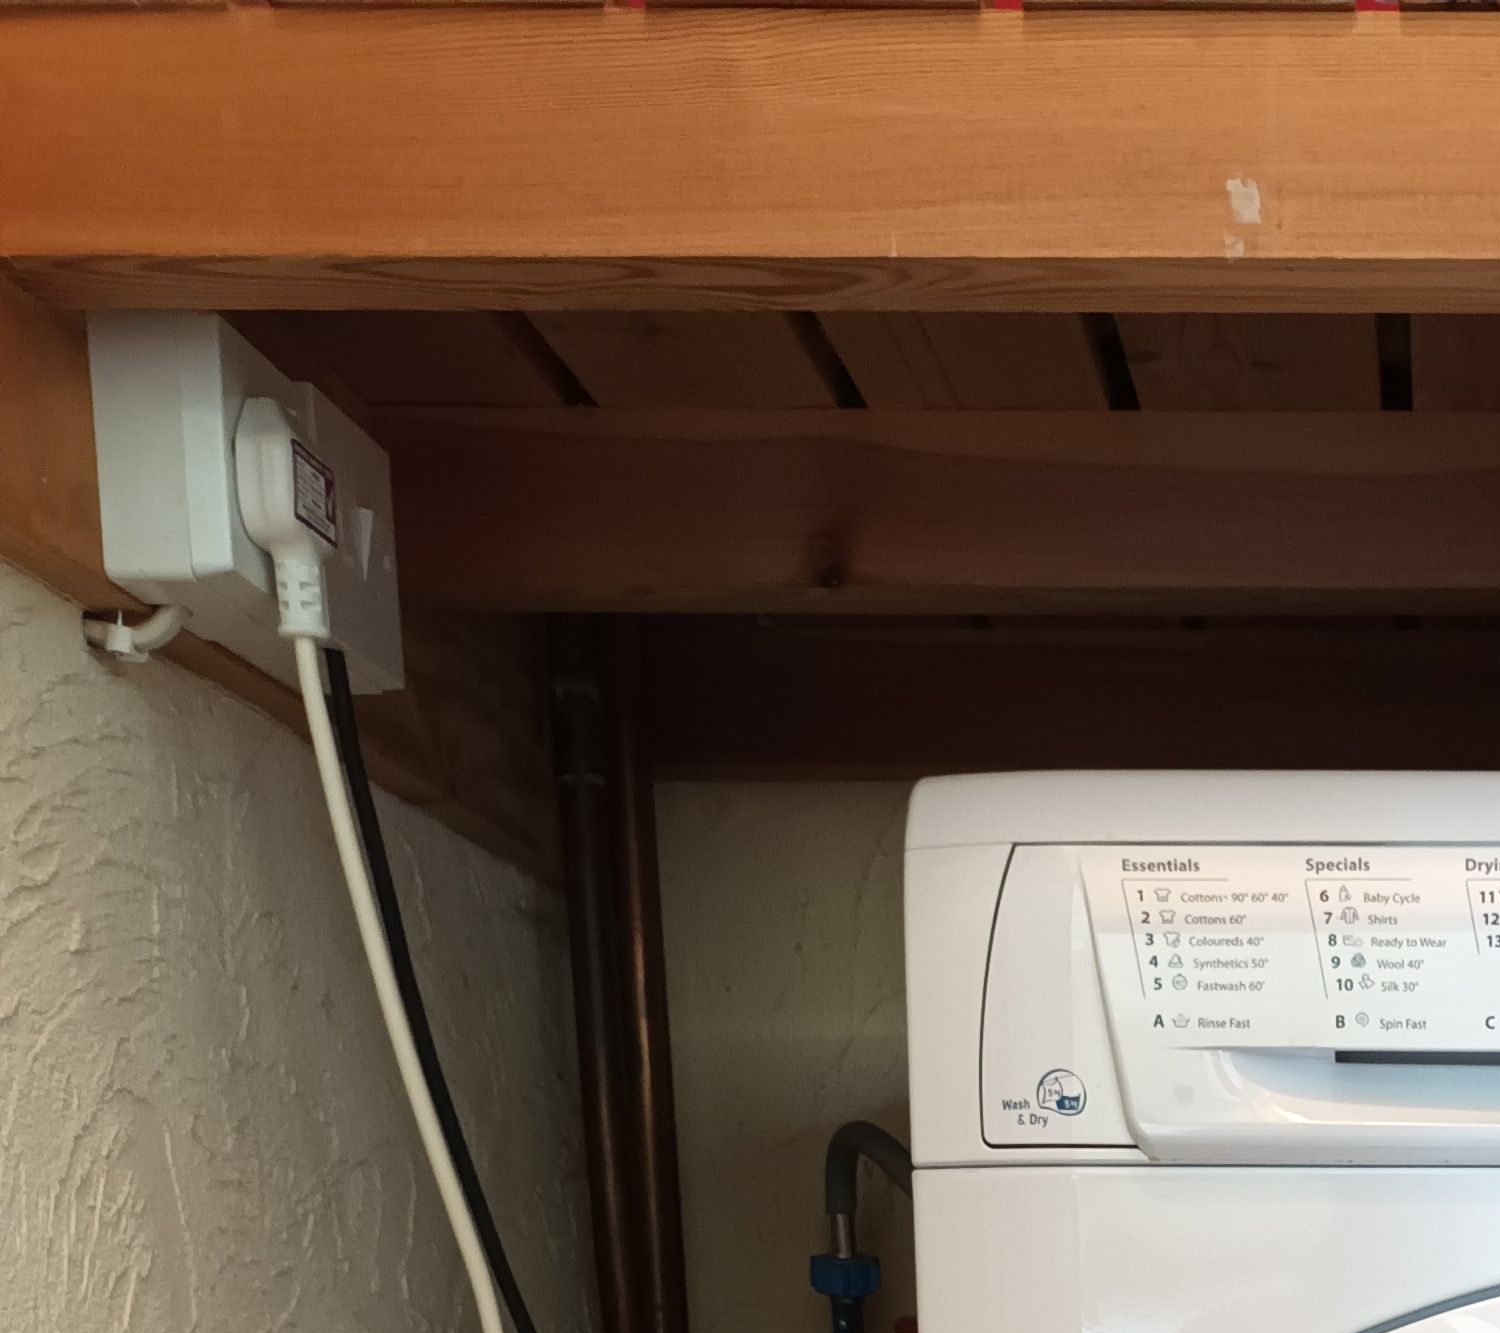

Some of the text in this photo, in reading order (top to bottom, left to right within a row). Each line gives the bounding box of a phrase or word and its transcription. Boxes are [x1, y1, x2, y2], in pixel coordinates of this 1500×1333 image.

[1122, 859, 1201, 872] Essentials
[1306, 858, 1370, 874] Specials
[1137, 890, 1144, 902] 1
[1320, 890, 1421, 905] 6 Baby Cycle
[1480, 891, 1495, 903] 11
[1141, 911, 1151, 924] 2
[1184, 914, 1227, 925] Cottons
[1324, 912, 1398, 926] 7 Shirts
[1483, 913, 1500, 926] 12
[1145, 933, 1154, 946] 3
[1189, 936, 1244, 947] Coloureds
[1328, 934, 1447, 949] 8 Ready to Wear
[1149, 955, 1158, 968] 4
[1193, 958, 1249, 970] Synthetics
[1331, 956, 1341, 969] 9
[1376, 959, 1405, 970] Wool
[1153, 977, 1162, 990] 5
[1197, 980, 1246, 991] Fastwash
[1337, 978, 1354, 992] 10
[1381, 981, 1399, 992] Silk
[1153, 1014, 1251, 1029] A Rinse Fast
[1335, 1014, 1427, 1031] B Spin Fast
[1485, 1015, 1496, 1029] C
[1002, 1099, 1030, 1110] Wash
[1017, 1113, 1048, 1128] & Dry
